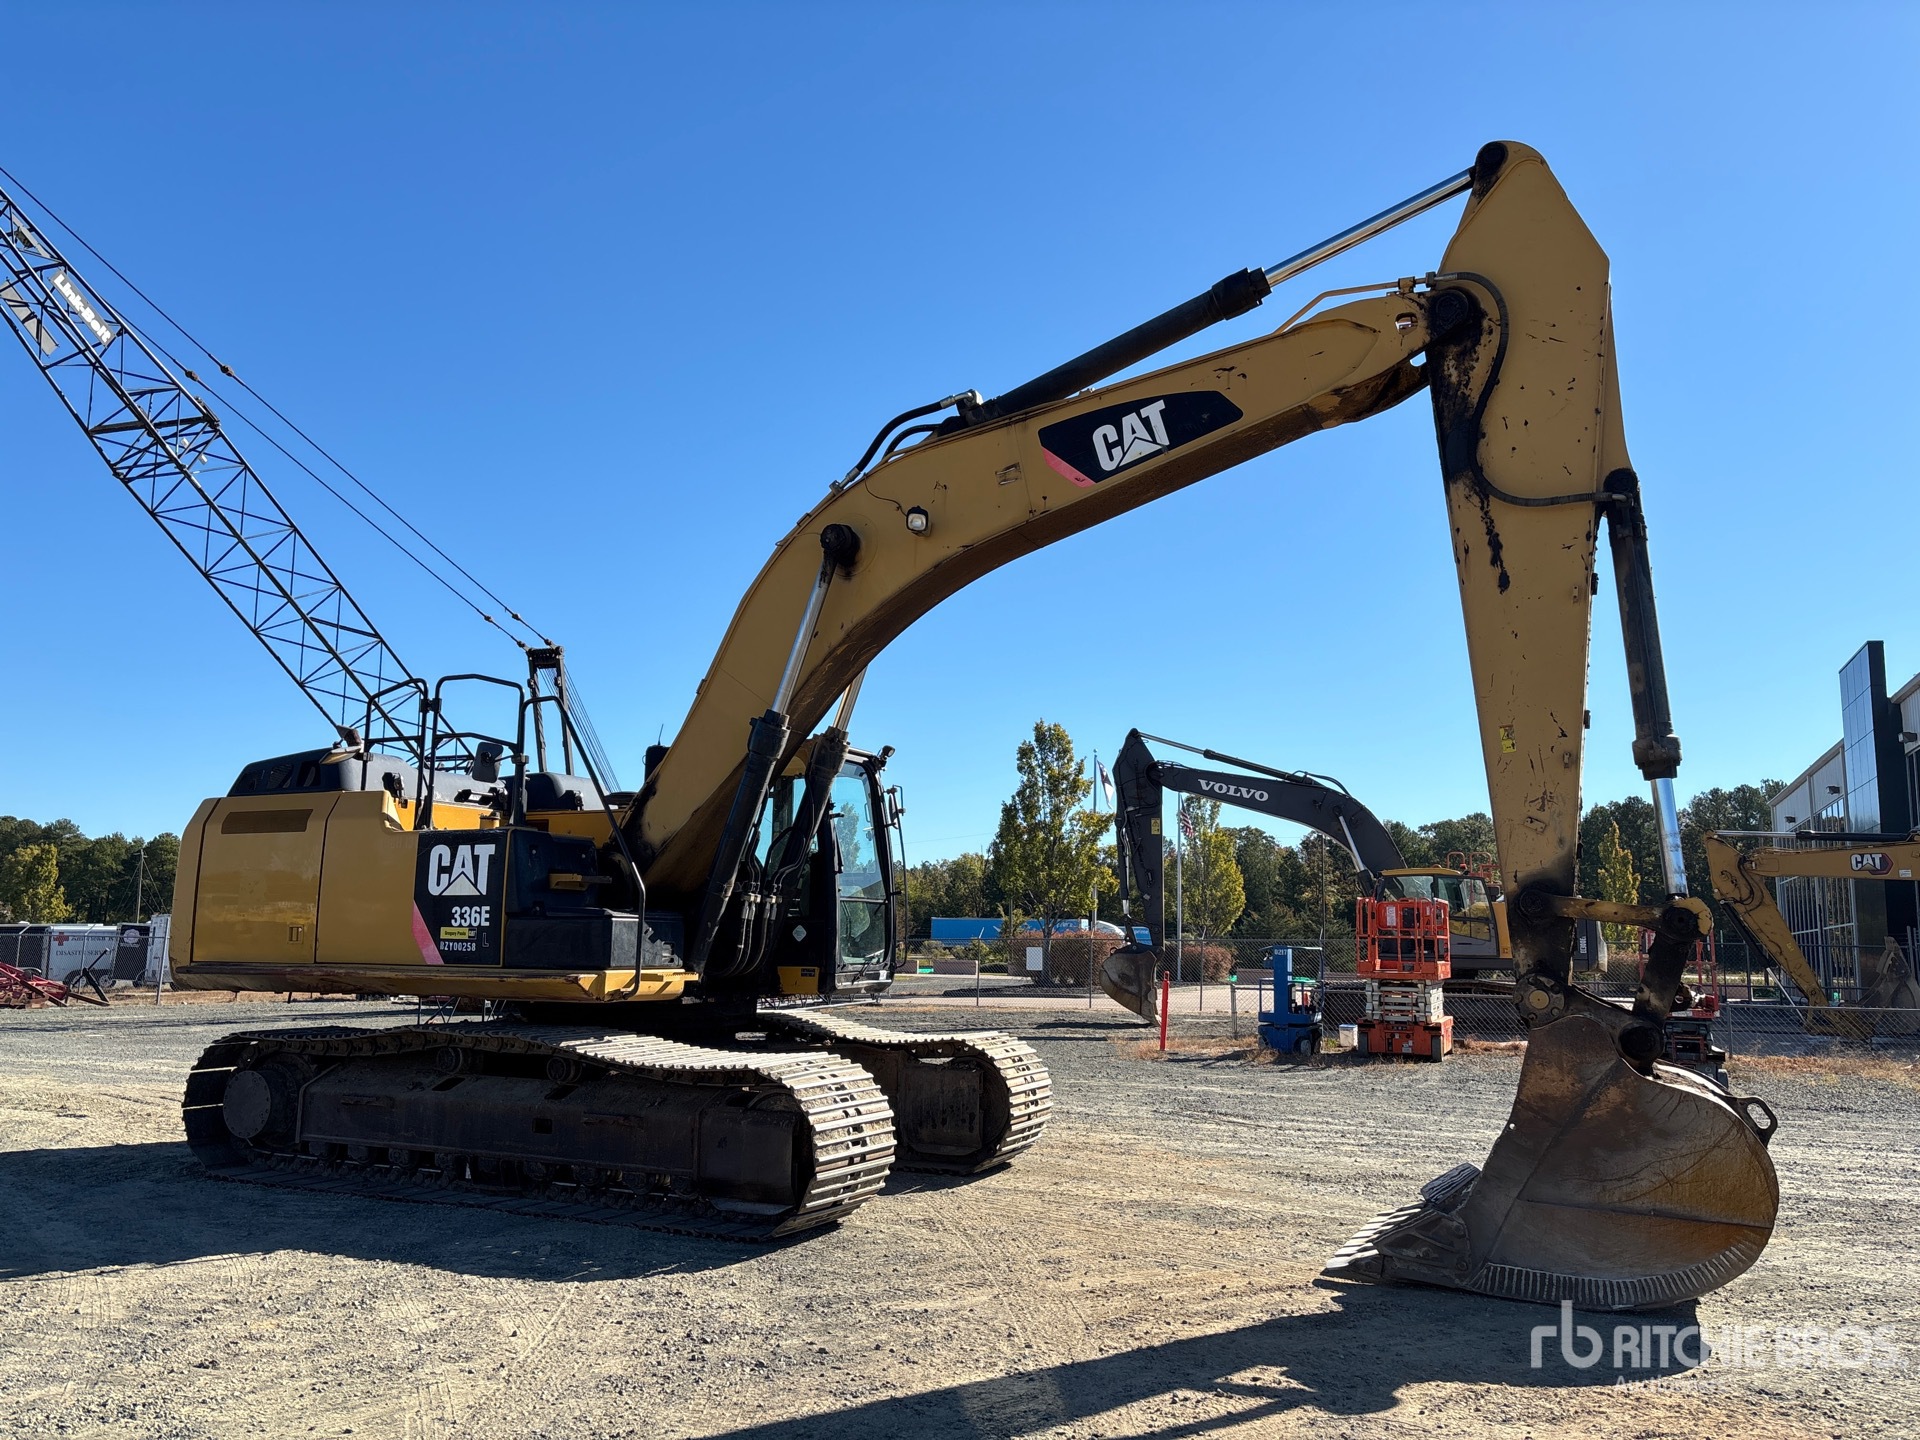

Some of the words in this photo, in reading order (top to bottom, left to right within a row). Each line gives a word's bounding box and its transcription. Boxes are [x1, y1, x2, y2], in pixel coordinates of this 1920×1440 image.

[1092, 399, 1170, 472] CAT
[1198, 779, 1269, 802] VOLVO
[428, 844, 496, 896] CAT
[1851, 853, 1882, 871] CAT
[451, 906, 490, 927] 336E
